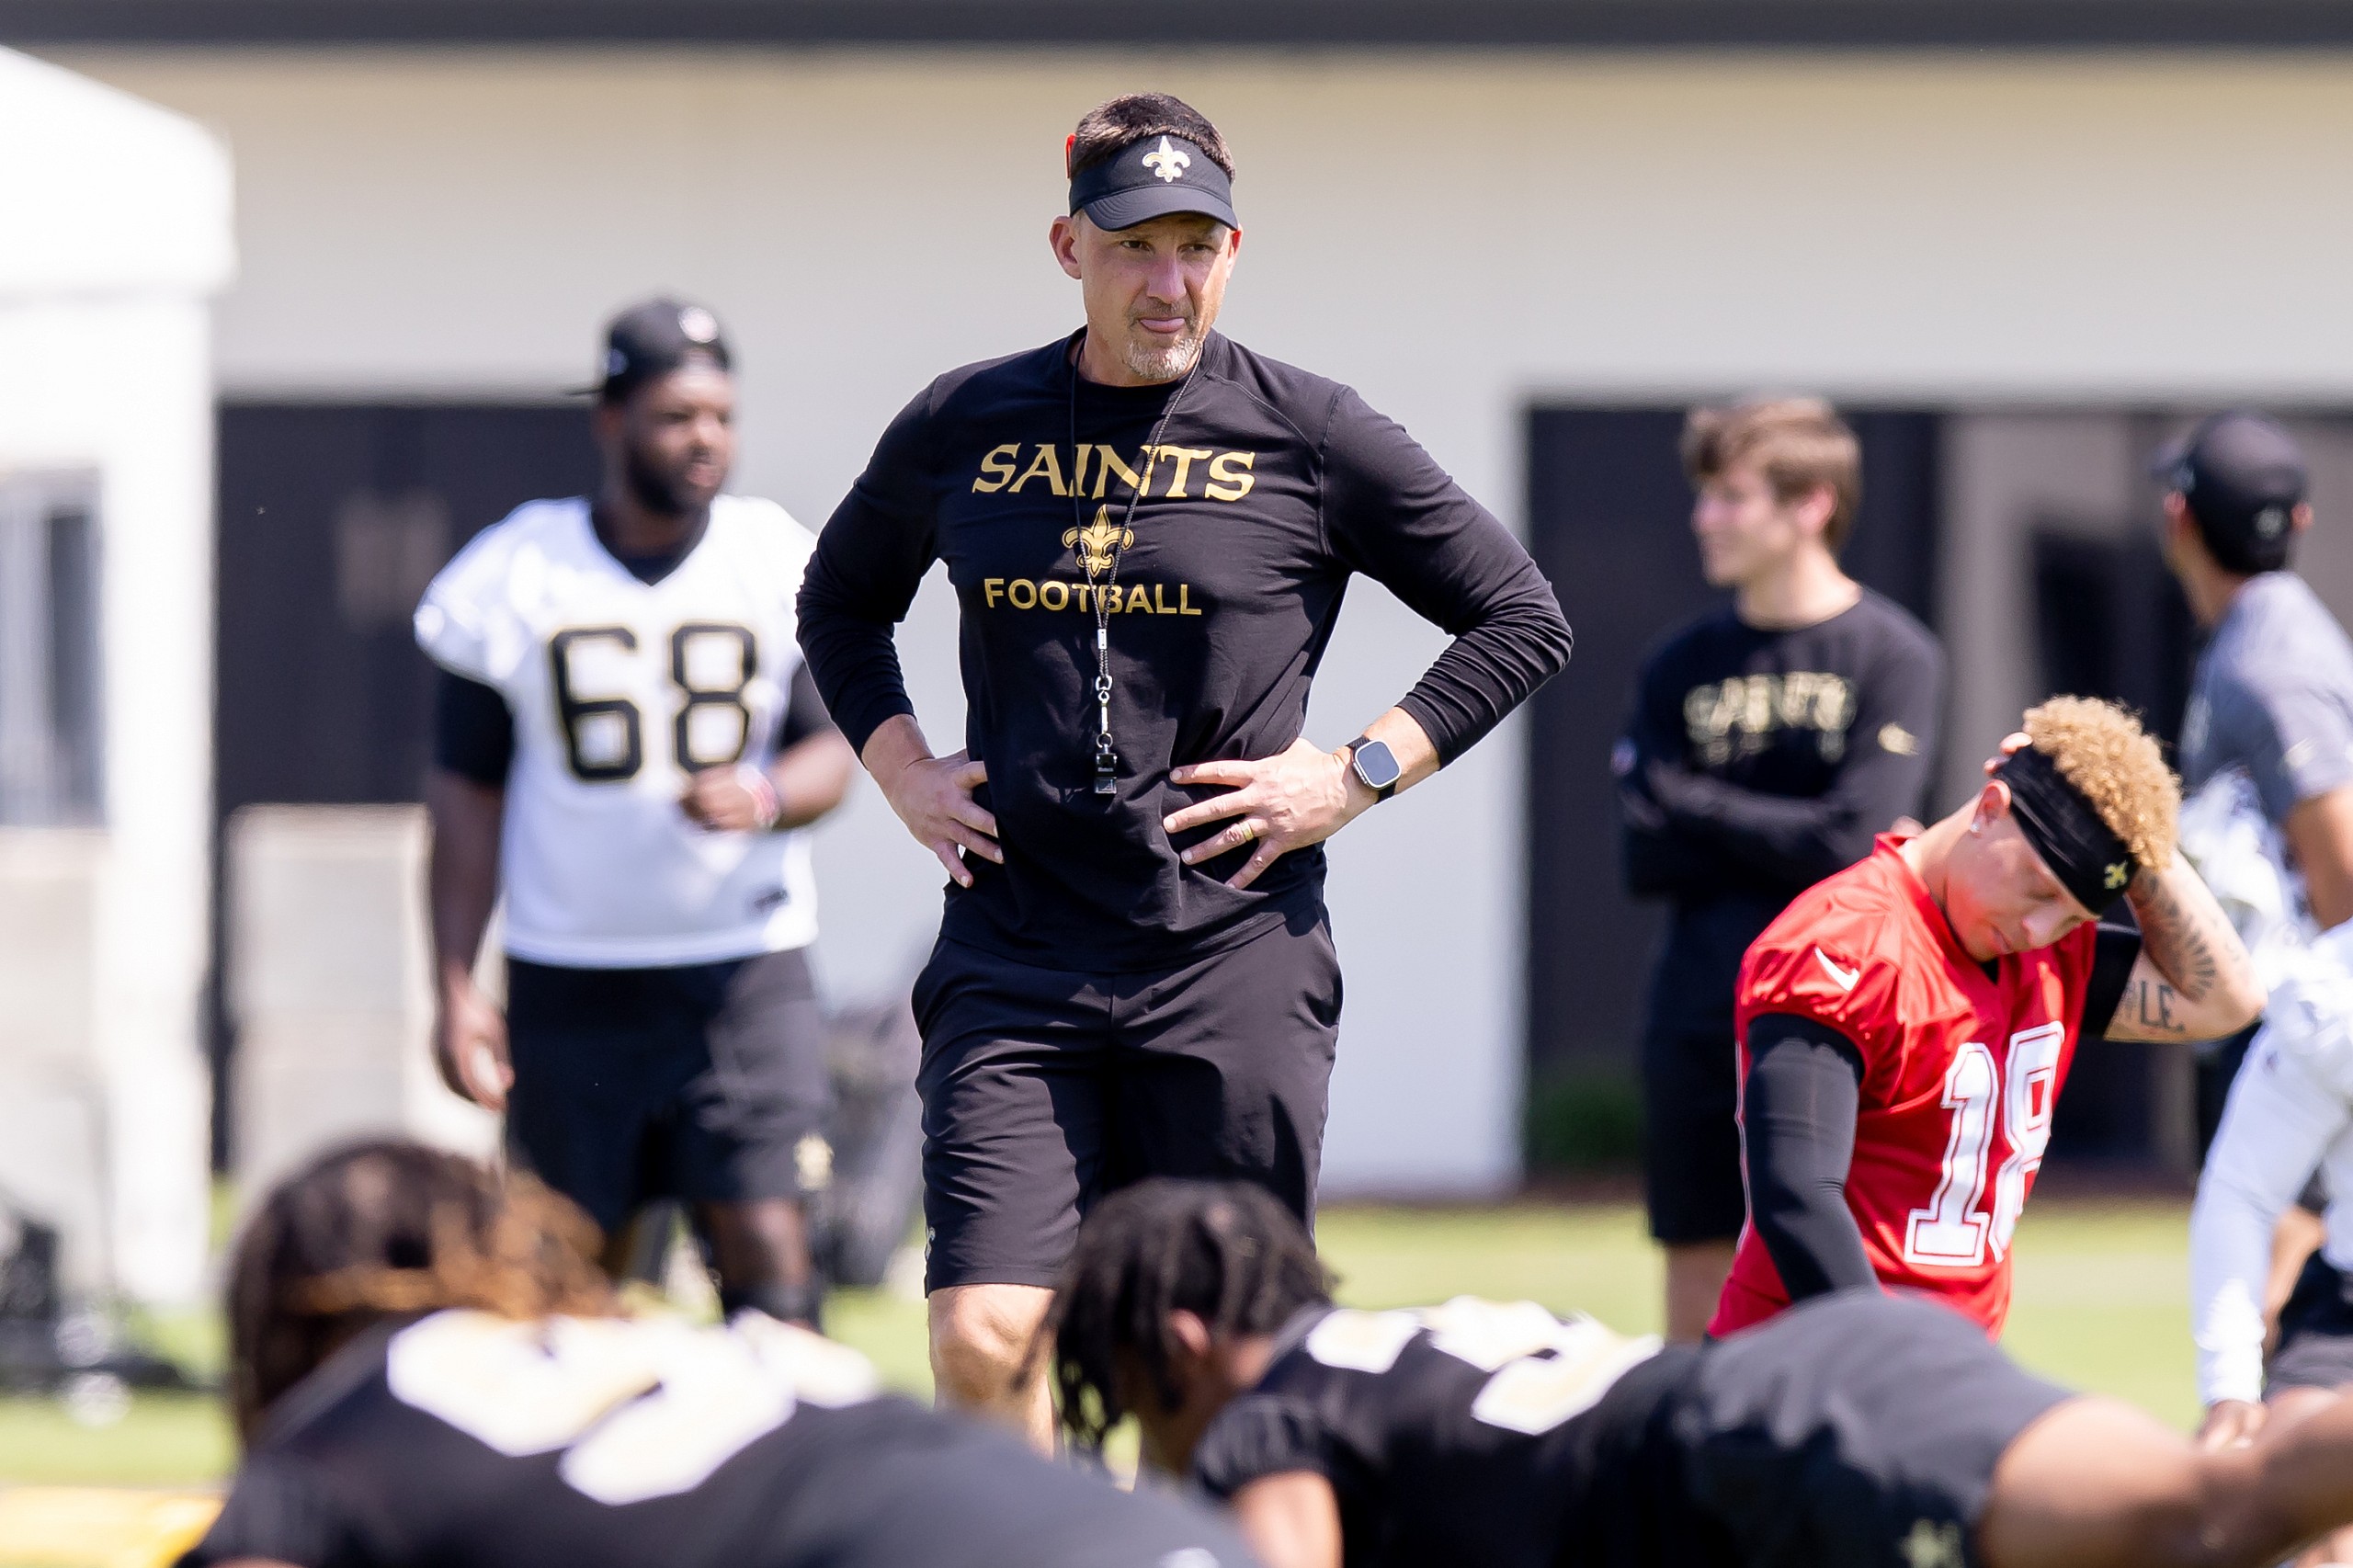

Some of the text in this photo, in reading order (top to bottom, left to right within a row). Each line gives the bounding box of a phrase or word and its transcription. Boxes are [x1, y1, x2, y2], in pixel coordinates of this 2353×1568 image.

[972, 442, 1256, 501] SAINTS
[983, 578, 1202, 616] FOOTBALL
[551, 623, 757, 782] 68
[1904, 1020, 2065, 1267] 18
